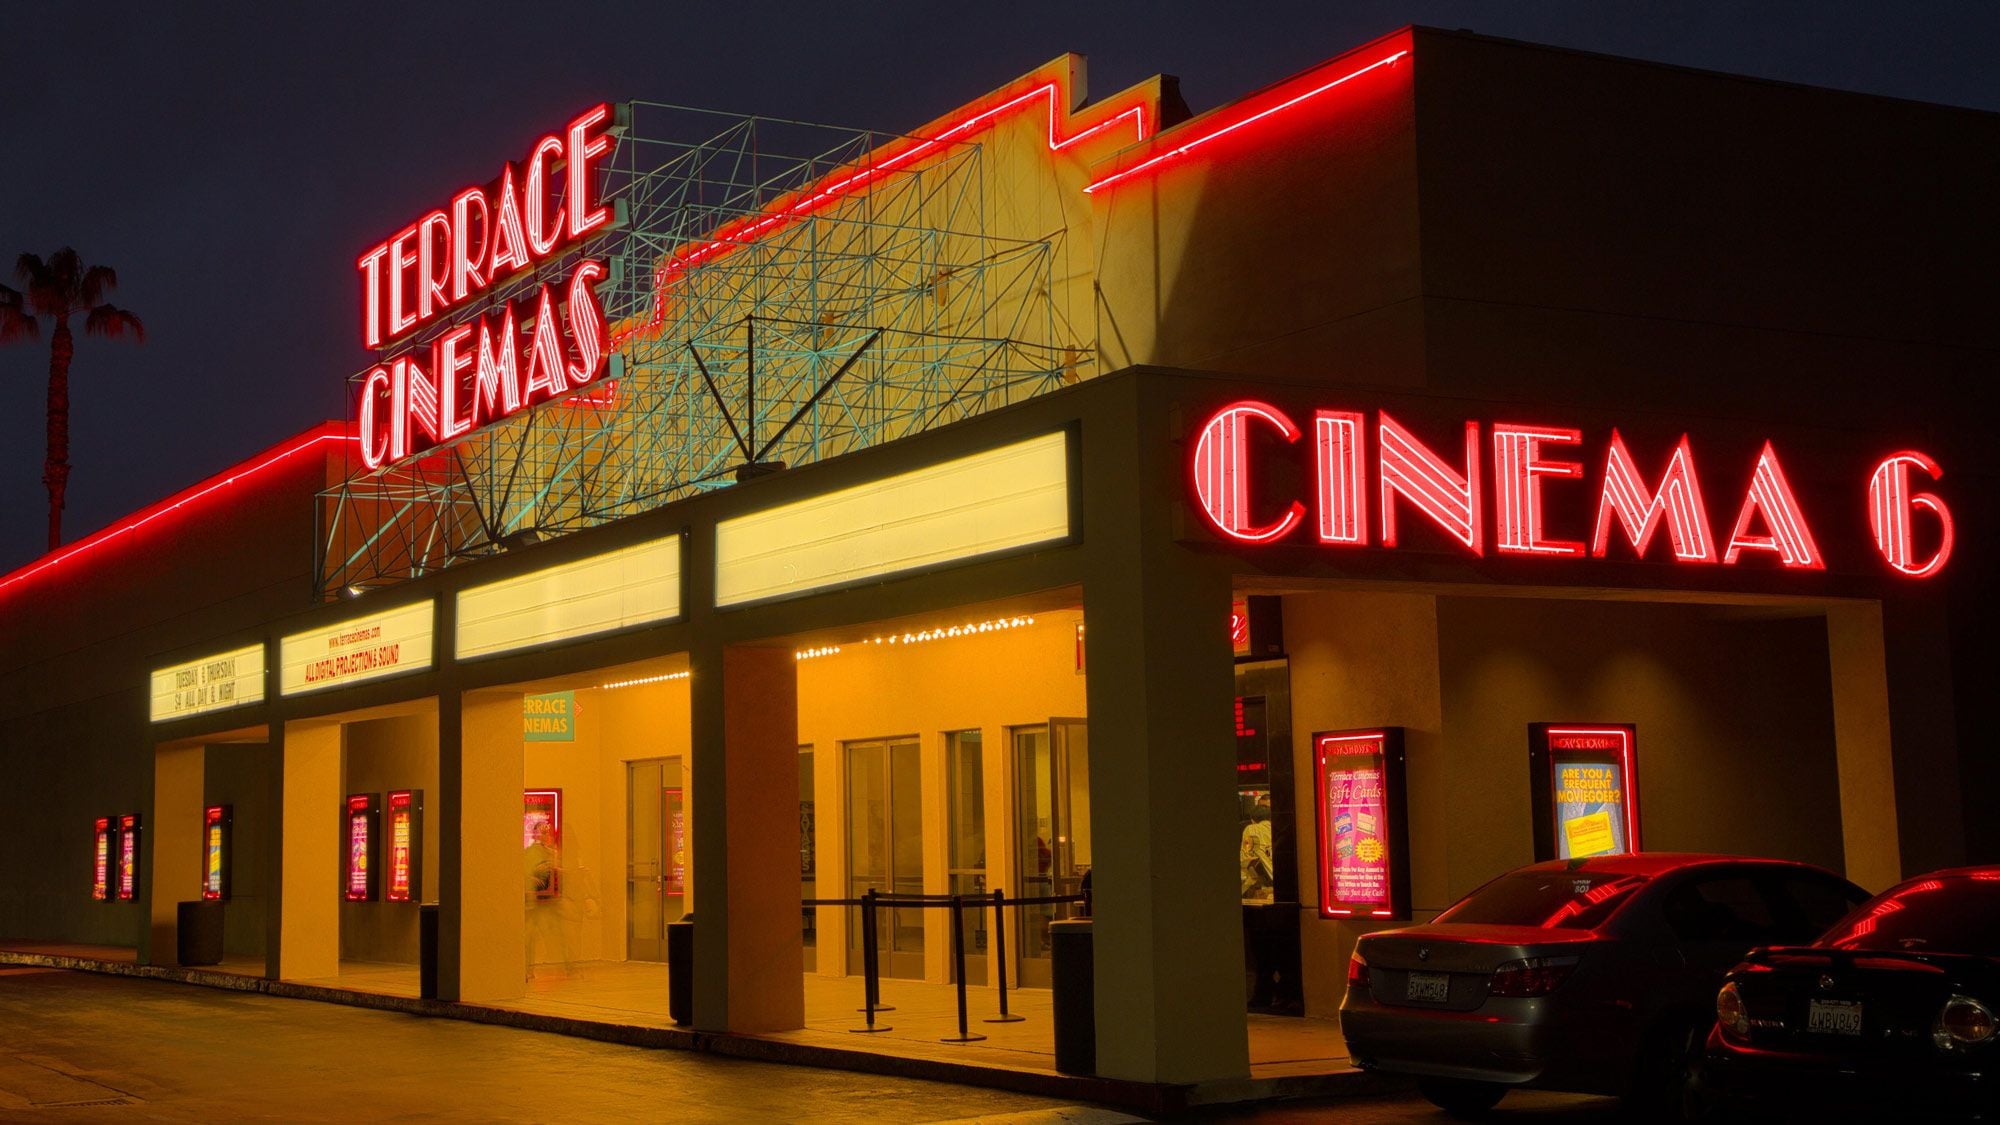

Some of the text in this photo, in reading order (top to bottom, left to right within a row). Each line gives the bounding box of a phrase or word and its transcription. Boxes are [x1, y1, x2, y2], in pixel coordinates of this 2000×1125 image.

[357, 102, 616, 350] TERRACE
[359, 262, 611, 471] CINEMAS
[1192, 399, 1955, 578] CINEMA 6
[176, 669, 198, 689] TUESDAY
[207, 659, 236, 682] THURSDAY
[305, 664, 314, 682] ALL
[315, 658, 336, 681] DIGITAL
[335, 650, 372, 677] PROJECTION
[378, 643, 399, 667] SOUND
[185, 690, 195, 707] ALL
[197, 687, 208, 705] DAY
[219, 681, 235, 701] NIGHT
[1330, 771, 1380, 781] Terrace Cinemas
[1562, 768, 1613, 779] ARE YOU A
[1563, 779, 1612, 789] FREQUENT
[1330, 782, 1382, 804] Gift Cards
[1557, 789, 1621, 804] MOVIEGOER?
